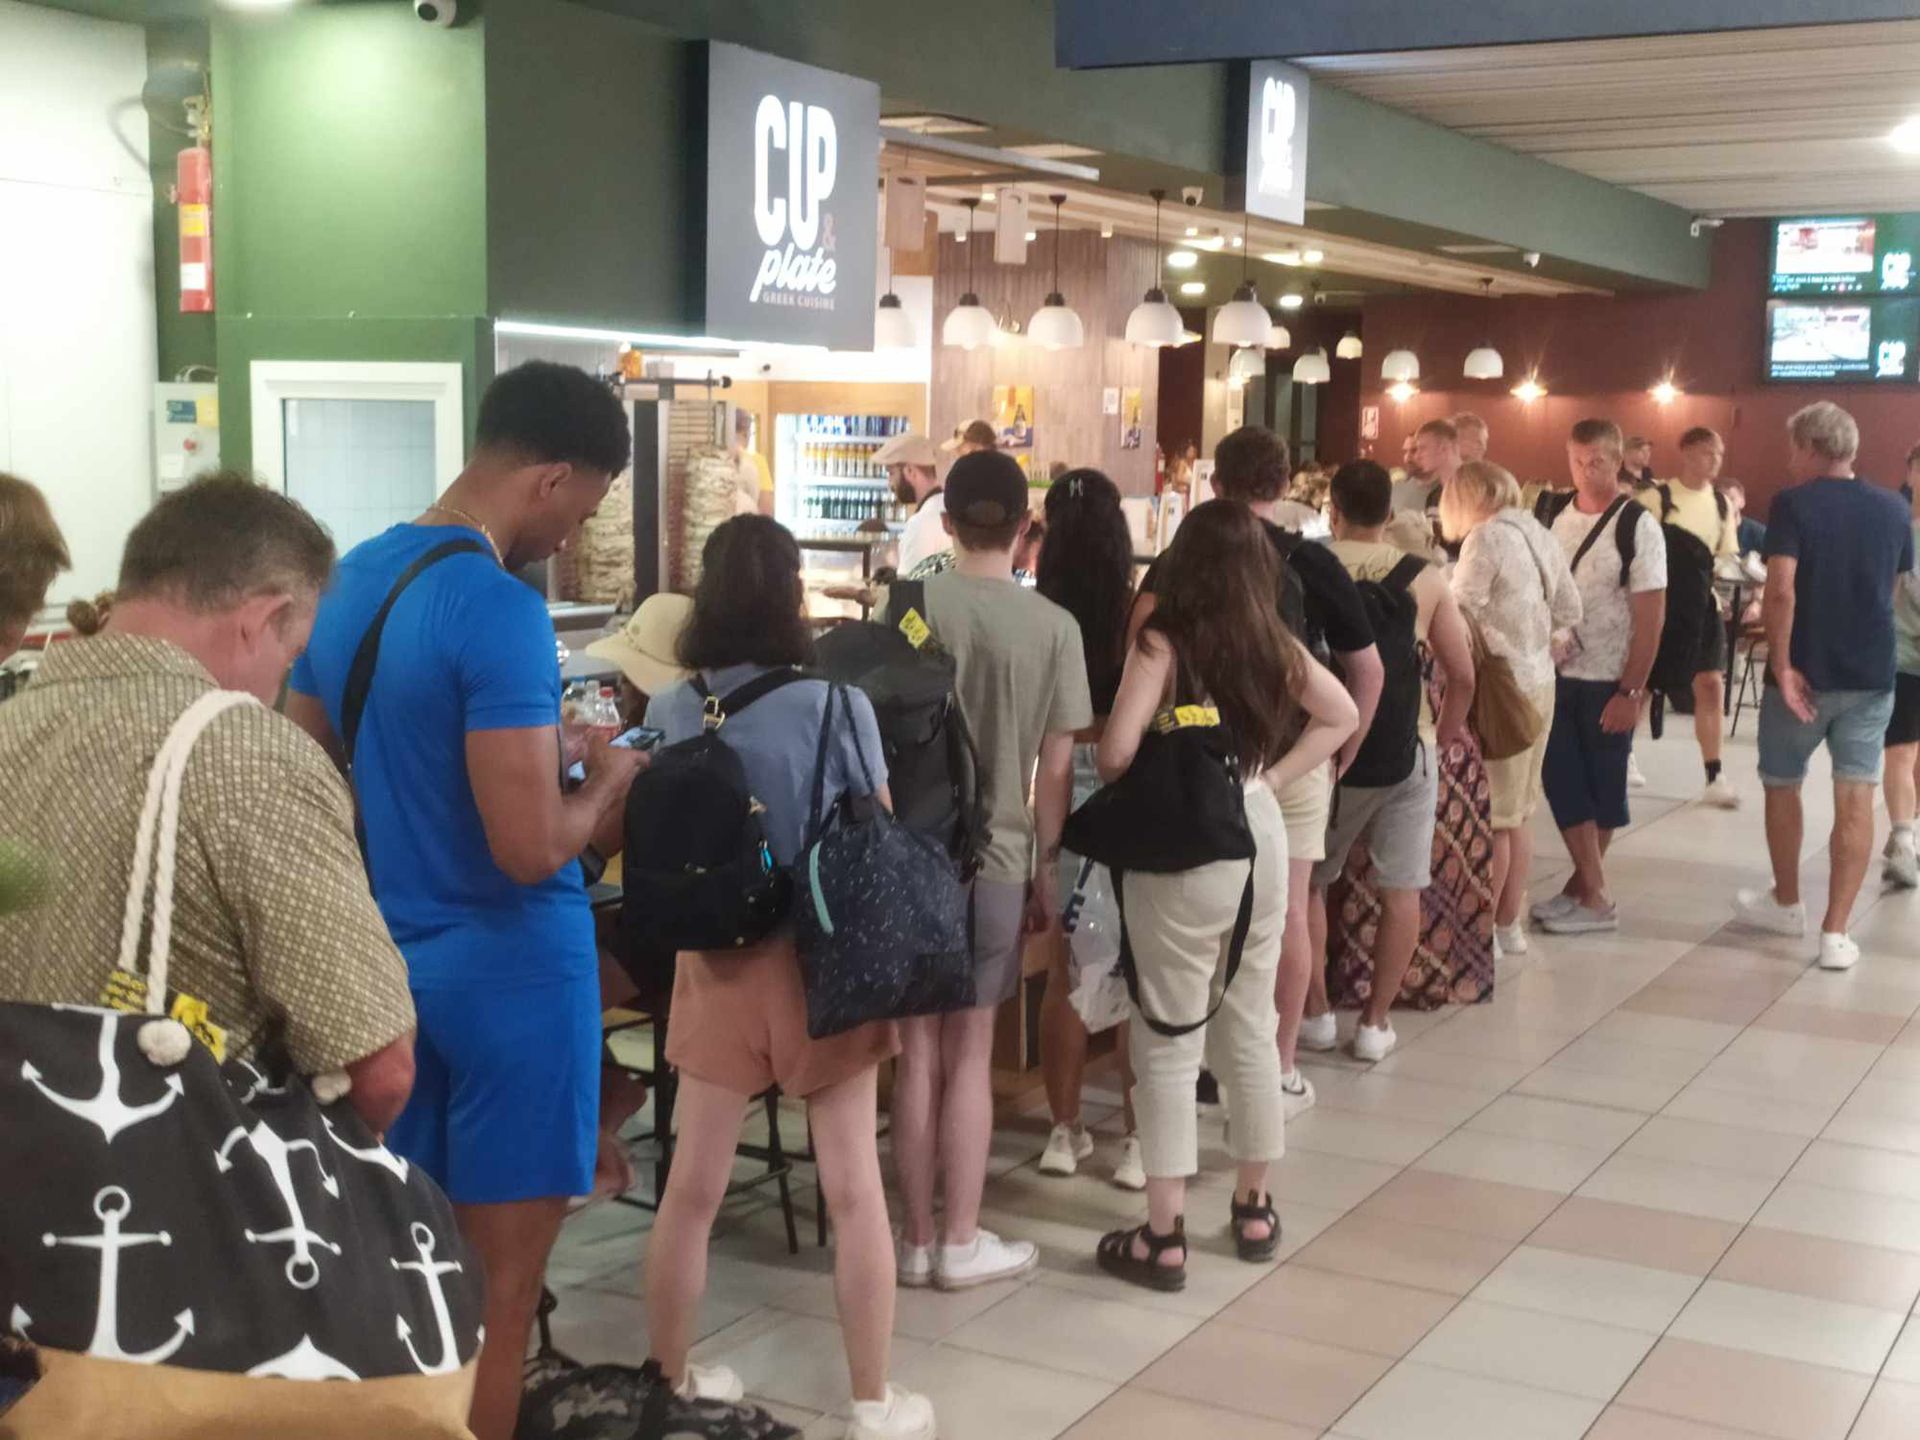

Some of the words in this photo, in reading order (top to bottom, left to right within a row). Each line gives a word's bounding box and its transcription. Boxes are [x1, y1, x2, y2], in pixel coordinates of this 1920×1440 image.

[754, 95, 838, 251] CUP
[821, 212, 836, 251] &
[749, 243, 837, 303] plate
[762, 290, 796, 307] GREEK
[797, 294, 835, 311] CUISINE
